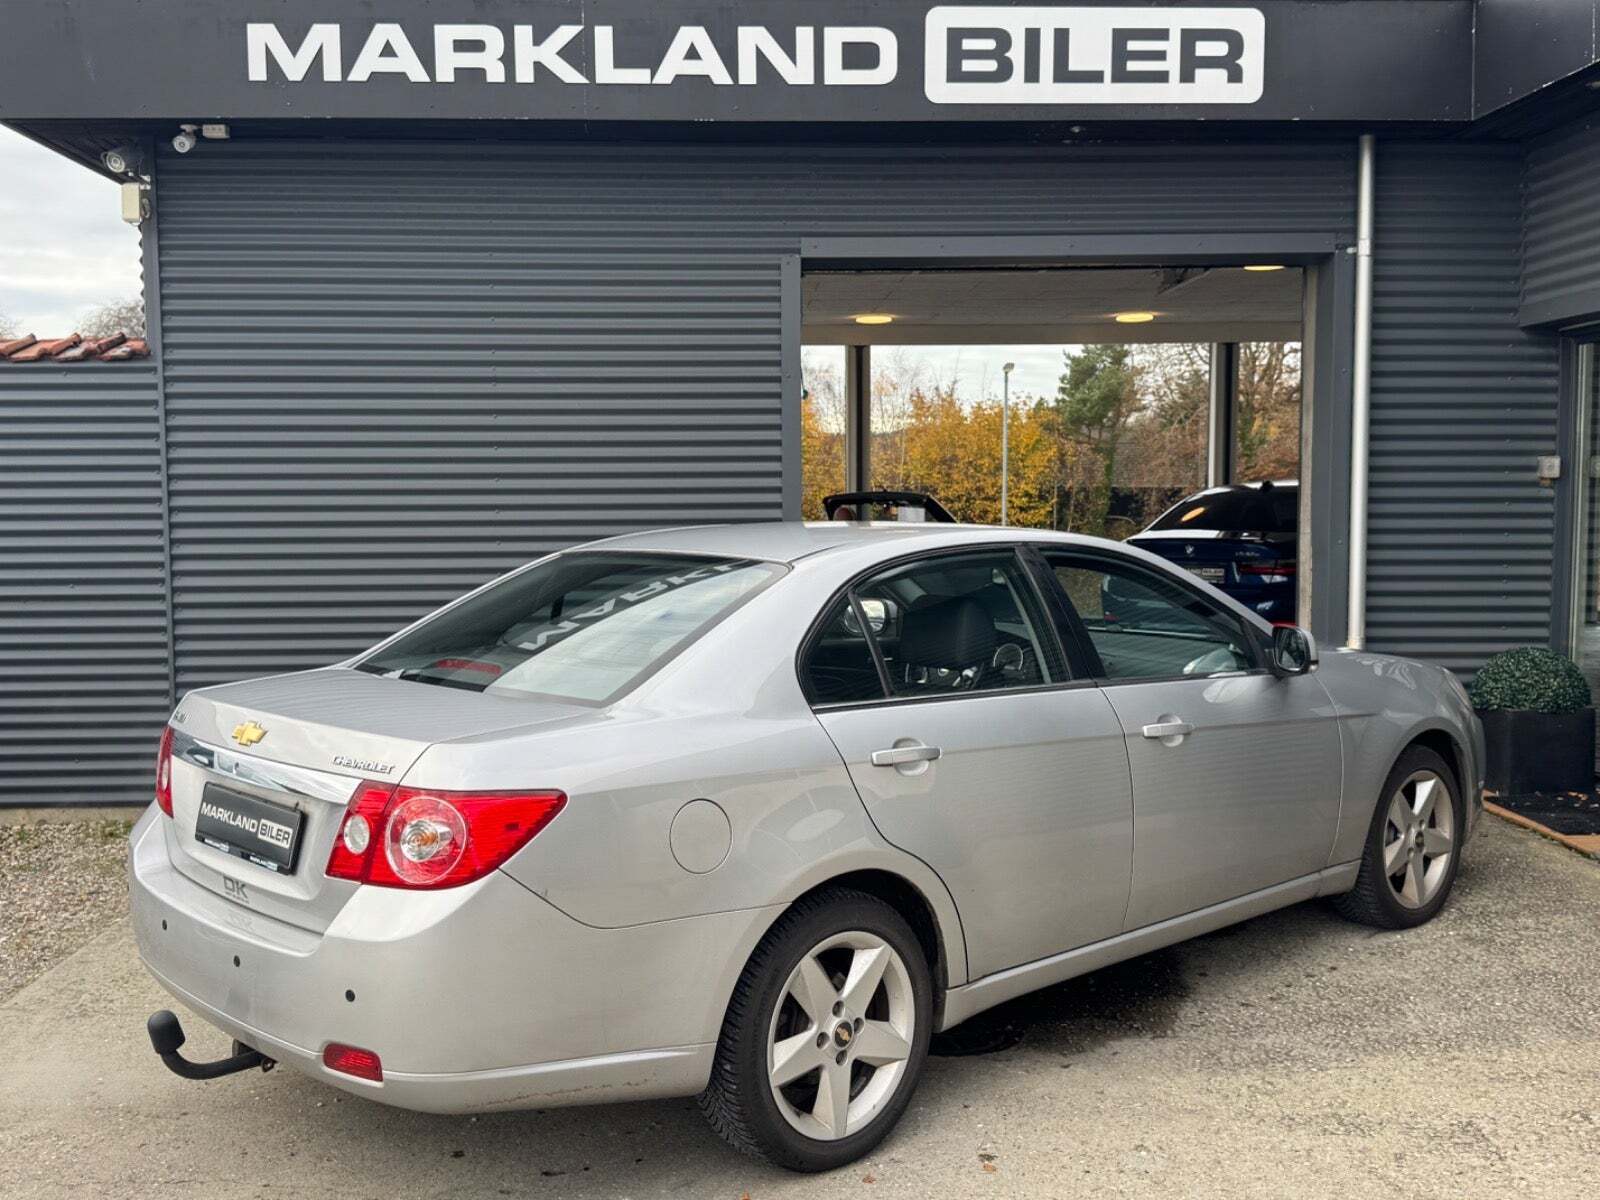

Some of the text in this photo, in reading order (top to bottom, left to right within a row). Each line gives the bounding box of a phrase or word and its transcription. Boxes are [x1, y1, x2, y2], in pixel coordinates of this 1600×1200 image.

[247, 23, 1244, 85] MARKLAND BILER
[332, 754, 396, 775] CHEVROLET
[200, 802, 259, 833] MARKLAND
[259, 822, 291, 847] BILER
